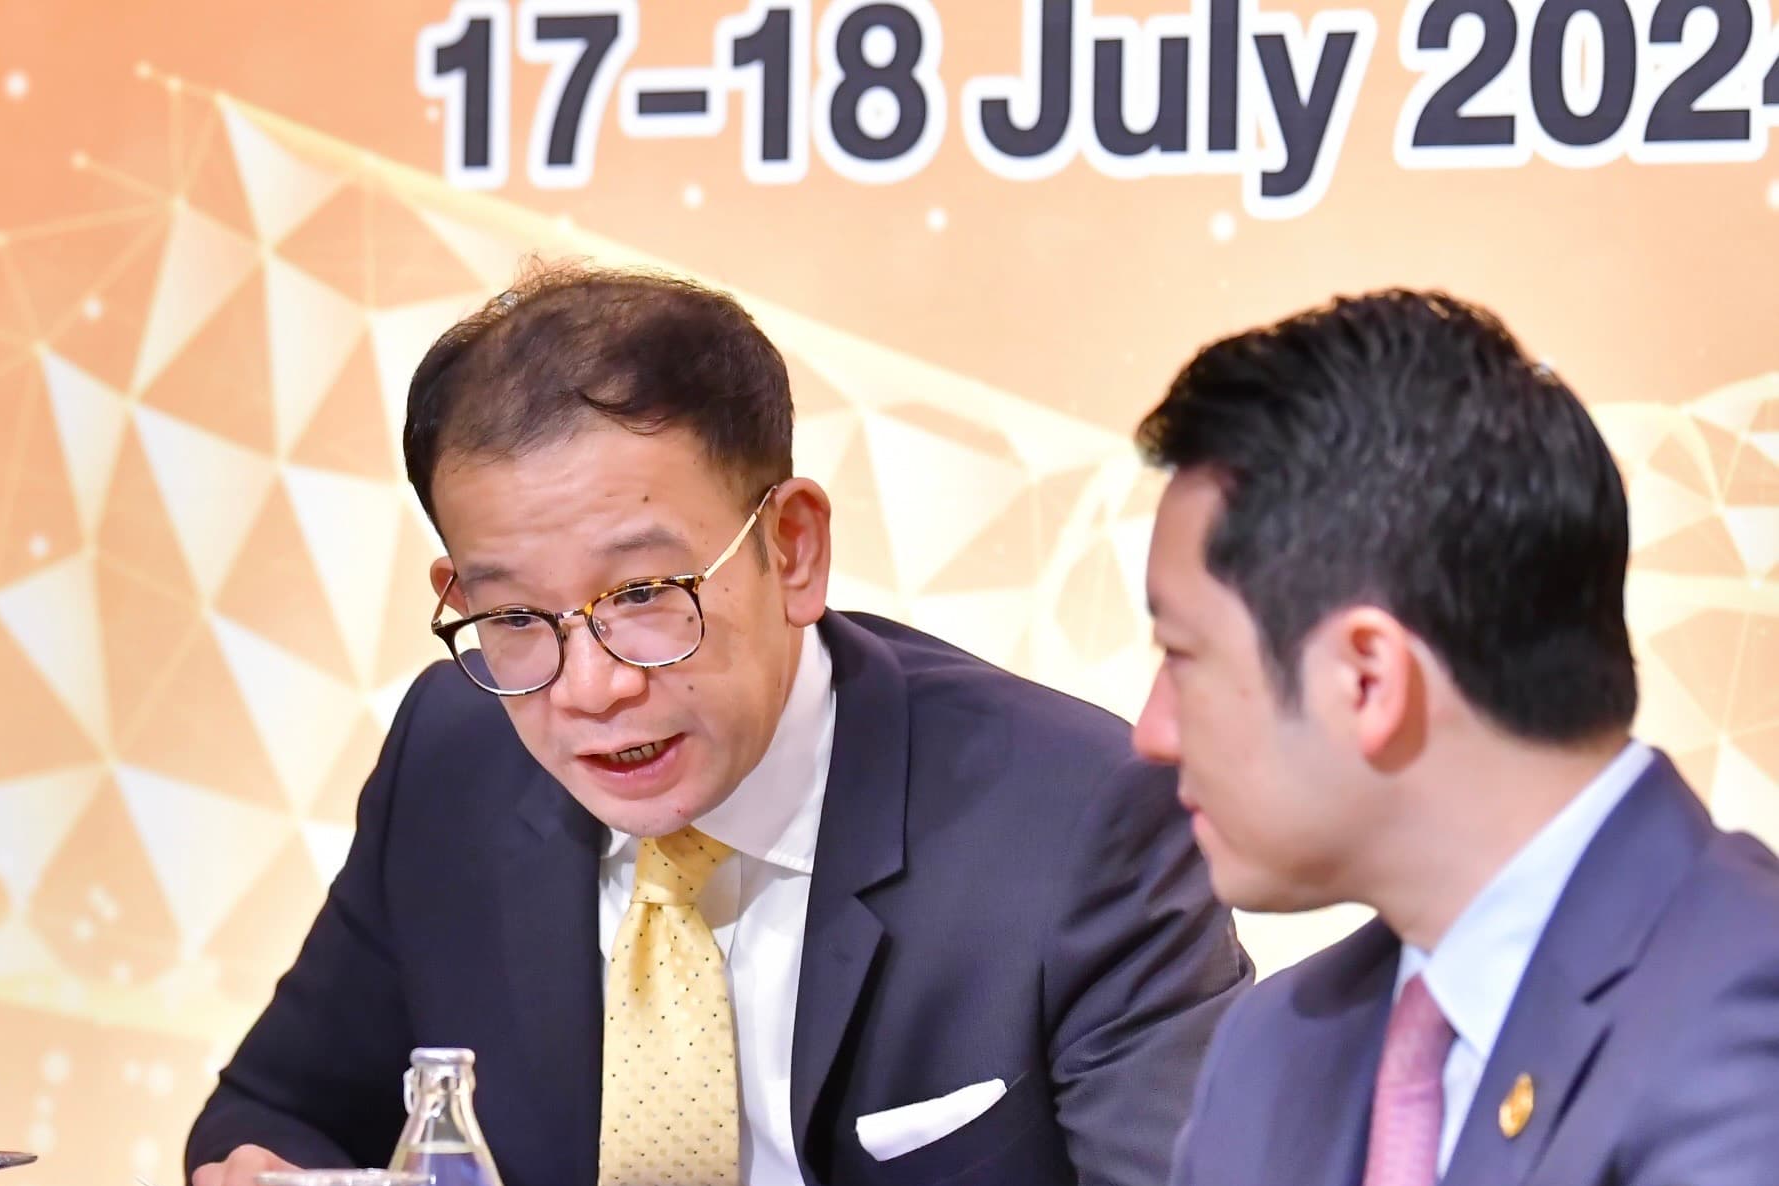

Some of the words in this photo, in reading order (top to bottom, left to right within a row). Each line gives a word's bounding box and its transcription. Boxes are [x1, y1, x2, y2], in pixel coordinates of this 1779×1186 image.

[434, 2, 929, 168] 17-18
[979, 0, 1358, 198] July
[1411, 0, 1779, 148] 202
